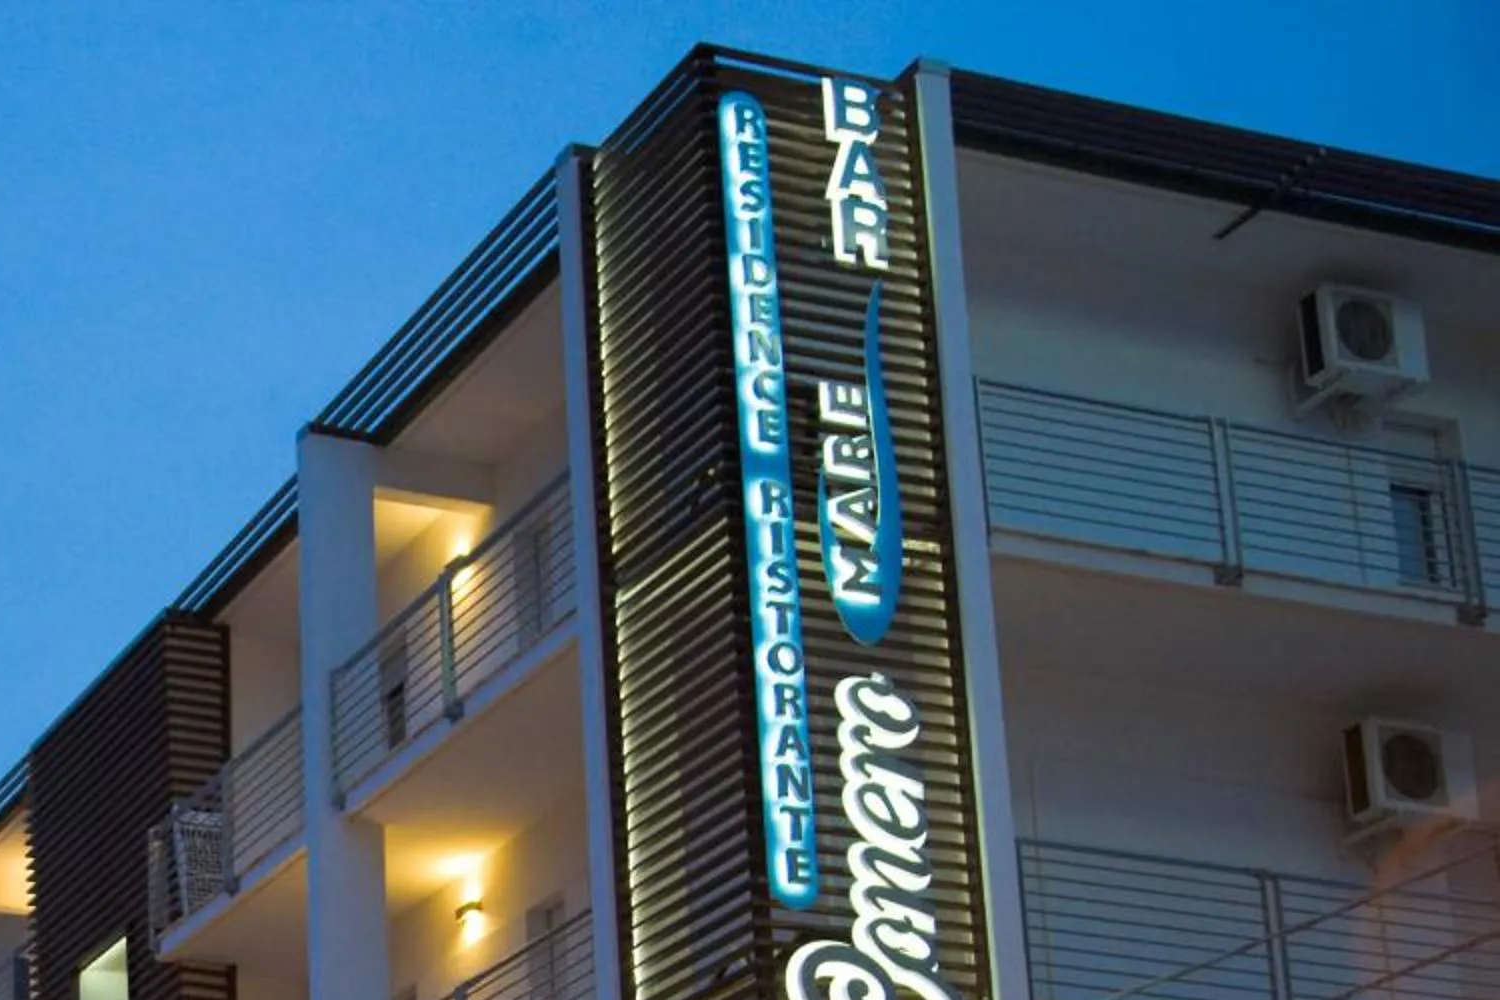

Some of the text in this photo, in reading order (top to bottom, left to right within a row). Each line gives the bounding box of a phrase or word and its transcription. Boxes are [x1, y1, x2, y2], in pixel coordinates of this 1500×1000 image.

[731, 100, 785, 449] RESIDENCE
[822, 77, 889, 270] BAR
[817, 380, 882, 605] MARE
[757, 479, 814, 887] RISTORANTE
